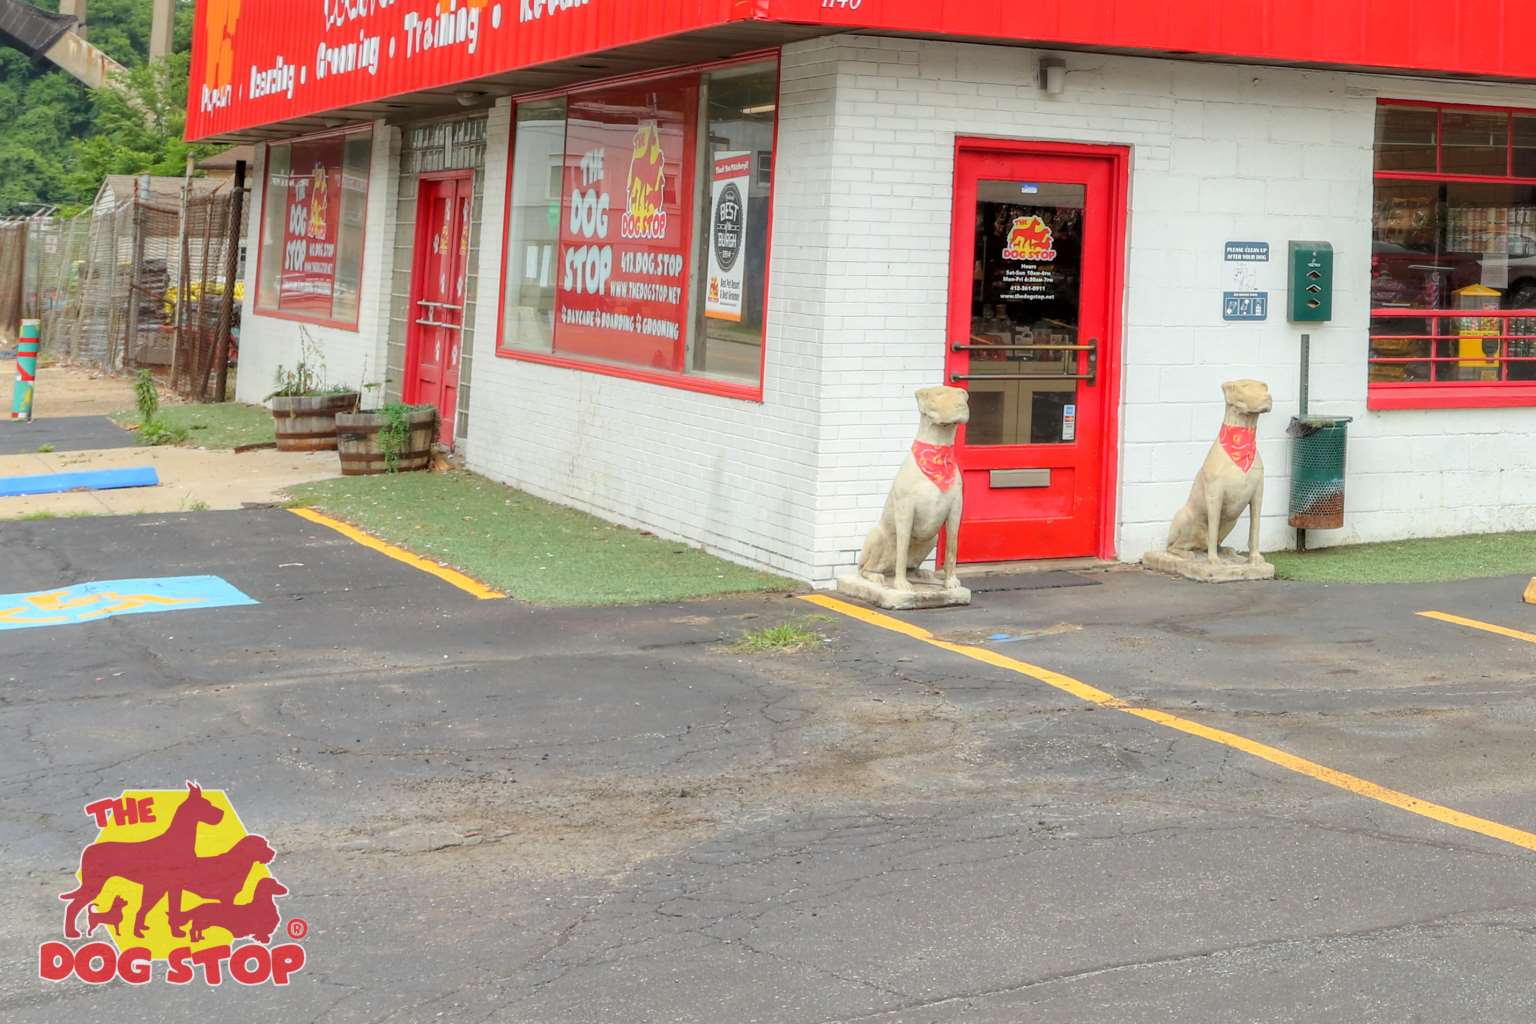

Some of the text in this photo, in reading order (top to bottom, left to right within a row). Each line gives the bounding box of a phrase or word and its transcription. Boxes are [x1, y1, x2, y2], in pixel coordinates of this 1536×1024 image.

[316, 29, 380, 80] Grooming
[581, 147, 605, 186] THE
[570, 188, 610, 239] DOG
[720, 202, 739, 222] BEST
[564, 244, 613, 296] STOP
[1003, 249, 1056, 261] DOG STOP
